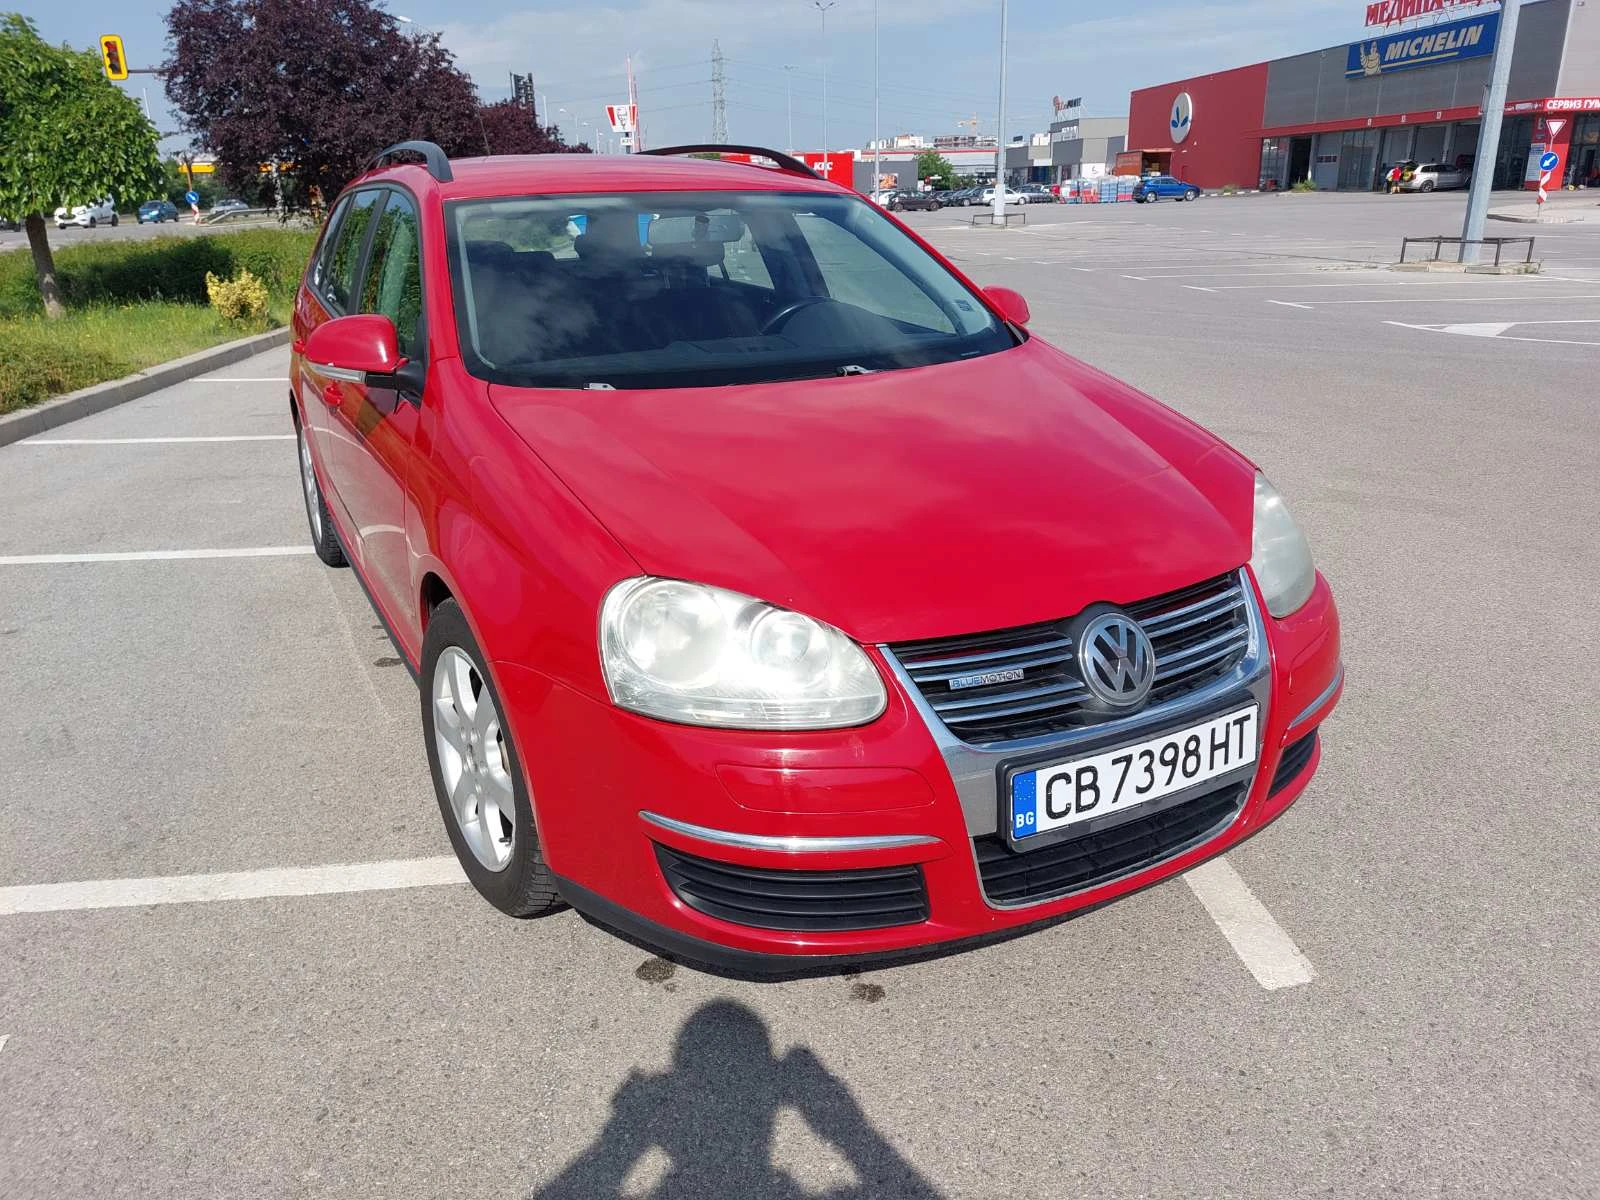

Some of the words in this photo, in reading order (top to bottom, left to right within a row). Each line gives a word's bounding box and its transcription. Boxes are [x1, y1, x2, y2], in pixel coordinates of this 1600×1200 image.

[1384, 24, 1484, 61] MICHELIN
[1546, 99, 1582, 109] СЕРВИЗ
[952, 671, 1022, 688] BLUEMOTION
[1045, 765, 1101, 820] CB
[1111, 734, 1202, 805] 7398
[1208, 714, 1251, 771] HT
[1015, 811, 1035, 828] BG
